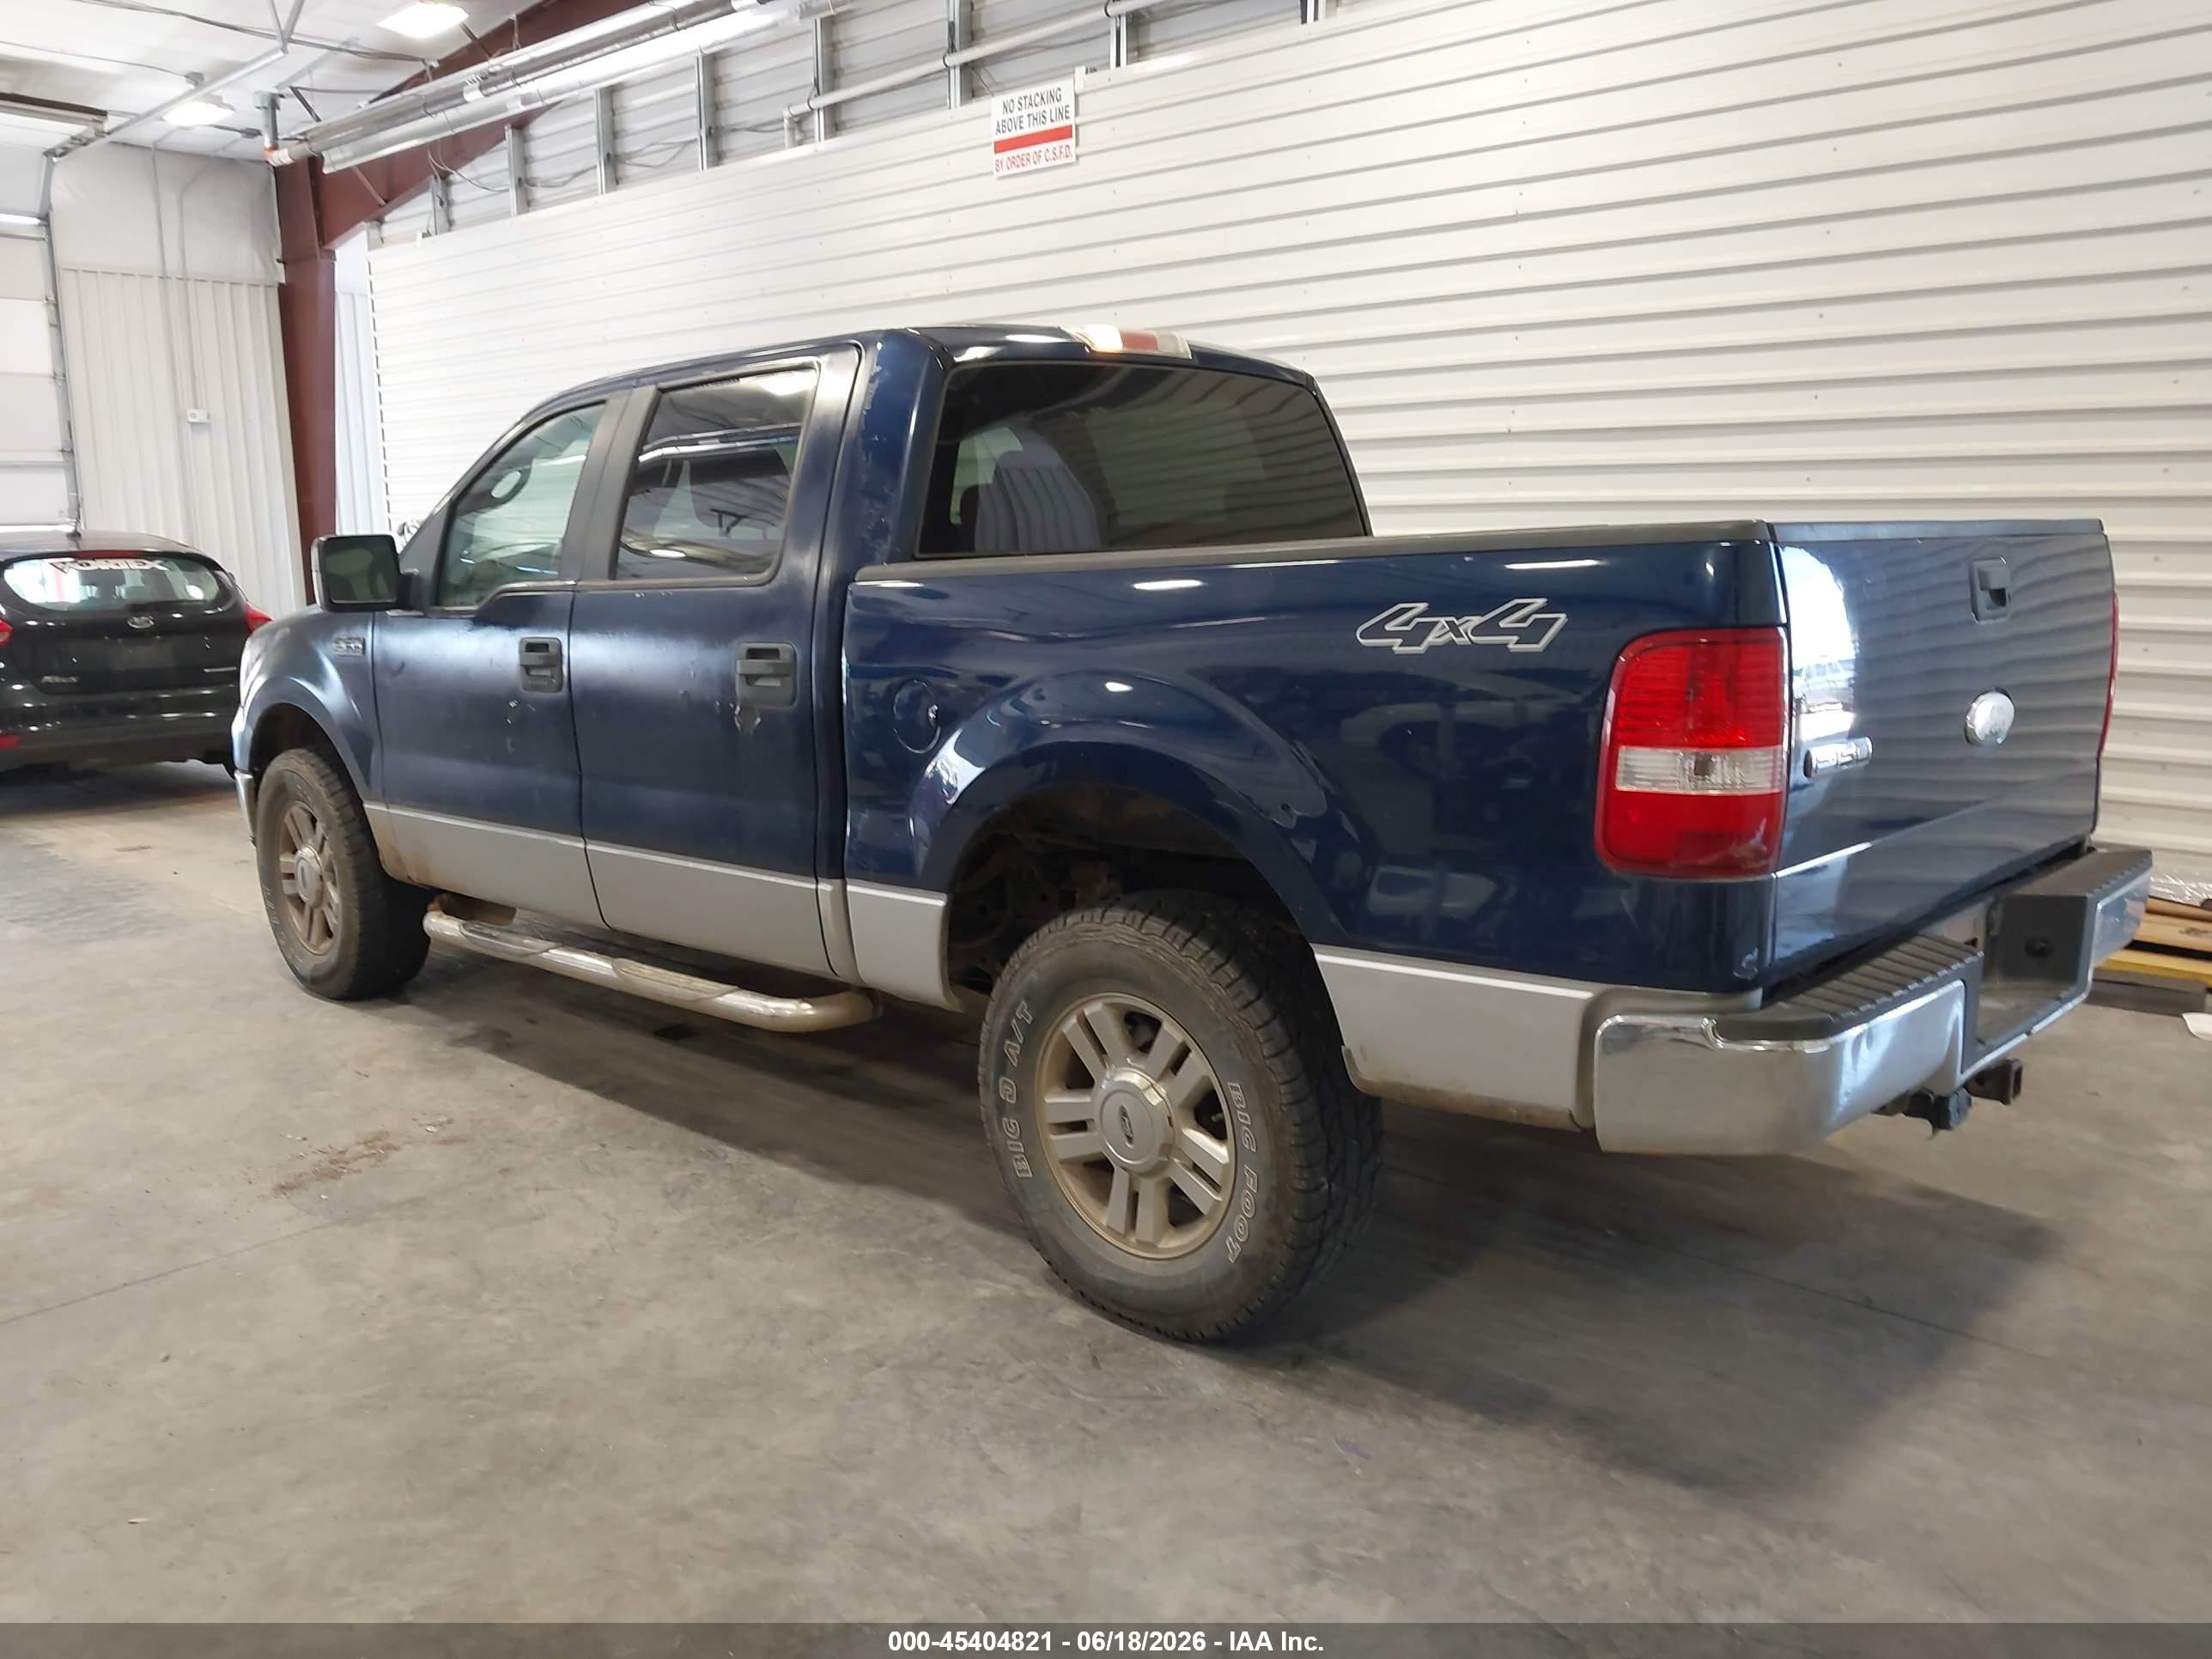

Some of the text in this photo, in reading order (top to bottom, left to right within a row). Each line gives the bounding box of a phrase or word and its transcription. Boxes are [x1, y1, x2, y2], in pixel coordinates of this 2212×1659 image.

[995, 104, 1071, 135] ABOVE THIS LINE
[1002, 87, 1062, 115] NO STACKING
[995, 158, 1004, 173] BY
[1006, 151, 1031, 170] ORDER
[1032, 149, 1042, 166] OF
[1004, 1000, 1033, 1067] A/T
[1004, 1117, 1033, 1178] BIG
[1227, 1081, 1259, 1264] BIG FOOT
